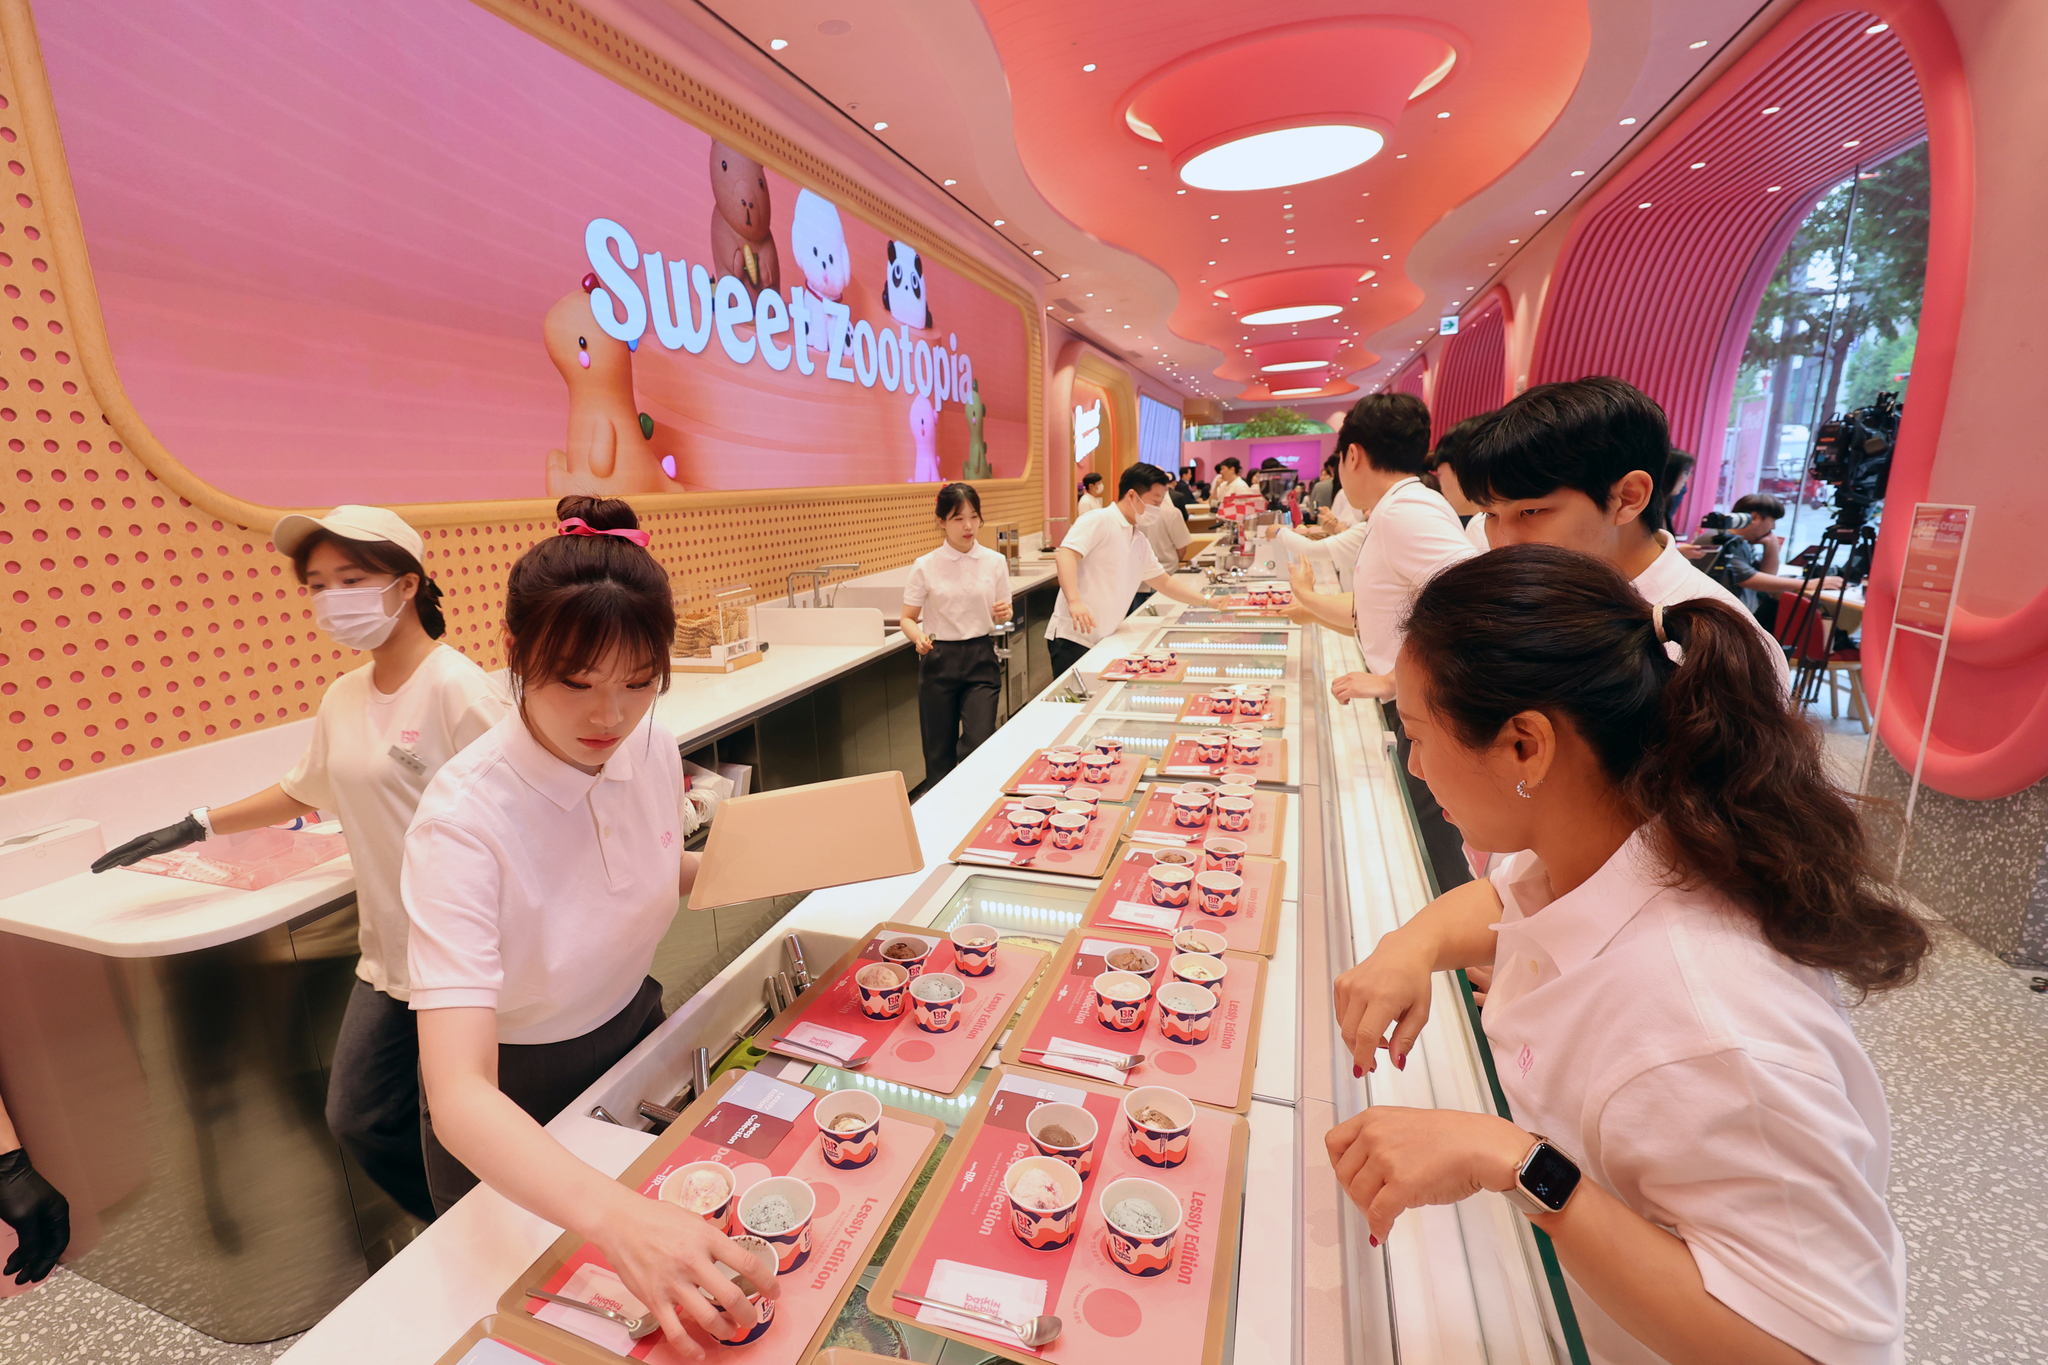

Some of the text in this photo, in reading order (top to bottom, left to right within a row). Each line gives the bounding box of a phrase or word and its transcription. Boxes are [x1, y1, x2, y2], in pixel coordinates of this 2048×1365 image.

[584, 218, 976, 412] Sweet Zootopia
[1940, 521, 1965, 533] Cream
[401, 730, 420, 744] BR
[660, 831, 674, 850] BR
[1226, 860, 1236, 868] BR
[1208, 896, 1220, 905] BR
[909, 966, 921, 978] BR
[888, 994, 900, 1006] BR
[983, 993, 1006, 1015] Lessly
[933, 1010, 948, 1020] BR
[1120, 1009, 1134, 1018] BR
[966, 1013, 991, 1040] Edition
[1221, 1000, 1240, 1050] Lessly Edition
[755, 1088, 779, 1110] Edition
[765, 1092, 785, 1112] Lessly
[727, 1114, 759, 1145] Collection
[743, 1122, 761, 1139] Deep
[824, 1137, 838, 1152] BR
[963, 1170, 976, 1183] BR
[978, 1174, 1013, 1236] ollection
[844, 1197, 879, 1239] Lessly
[1016, 1211, 1033, 1230] BR
[1113, 1235, 1131, 1255] BR
[1177, 1191, 1207, 1285] Lessly Edition
[810, 1239, 853, 1291] Edition
[592, 1293, 623, 1310] robbins
[964, 1302, 1000, 1317] robbins
[965, 1293, 1001, 1309] baskin
